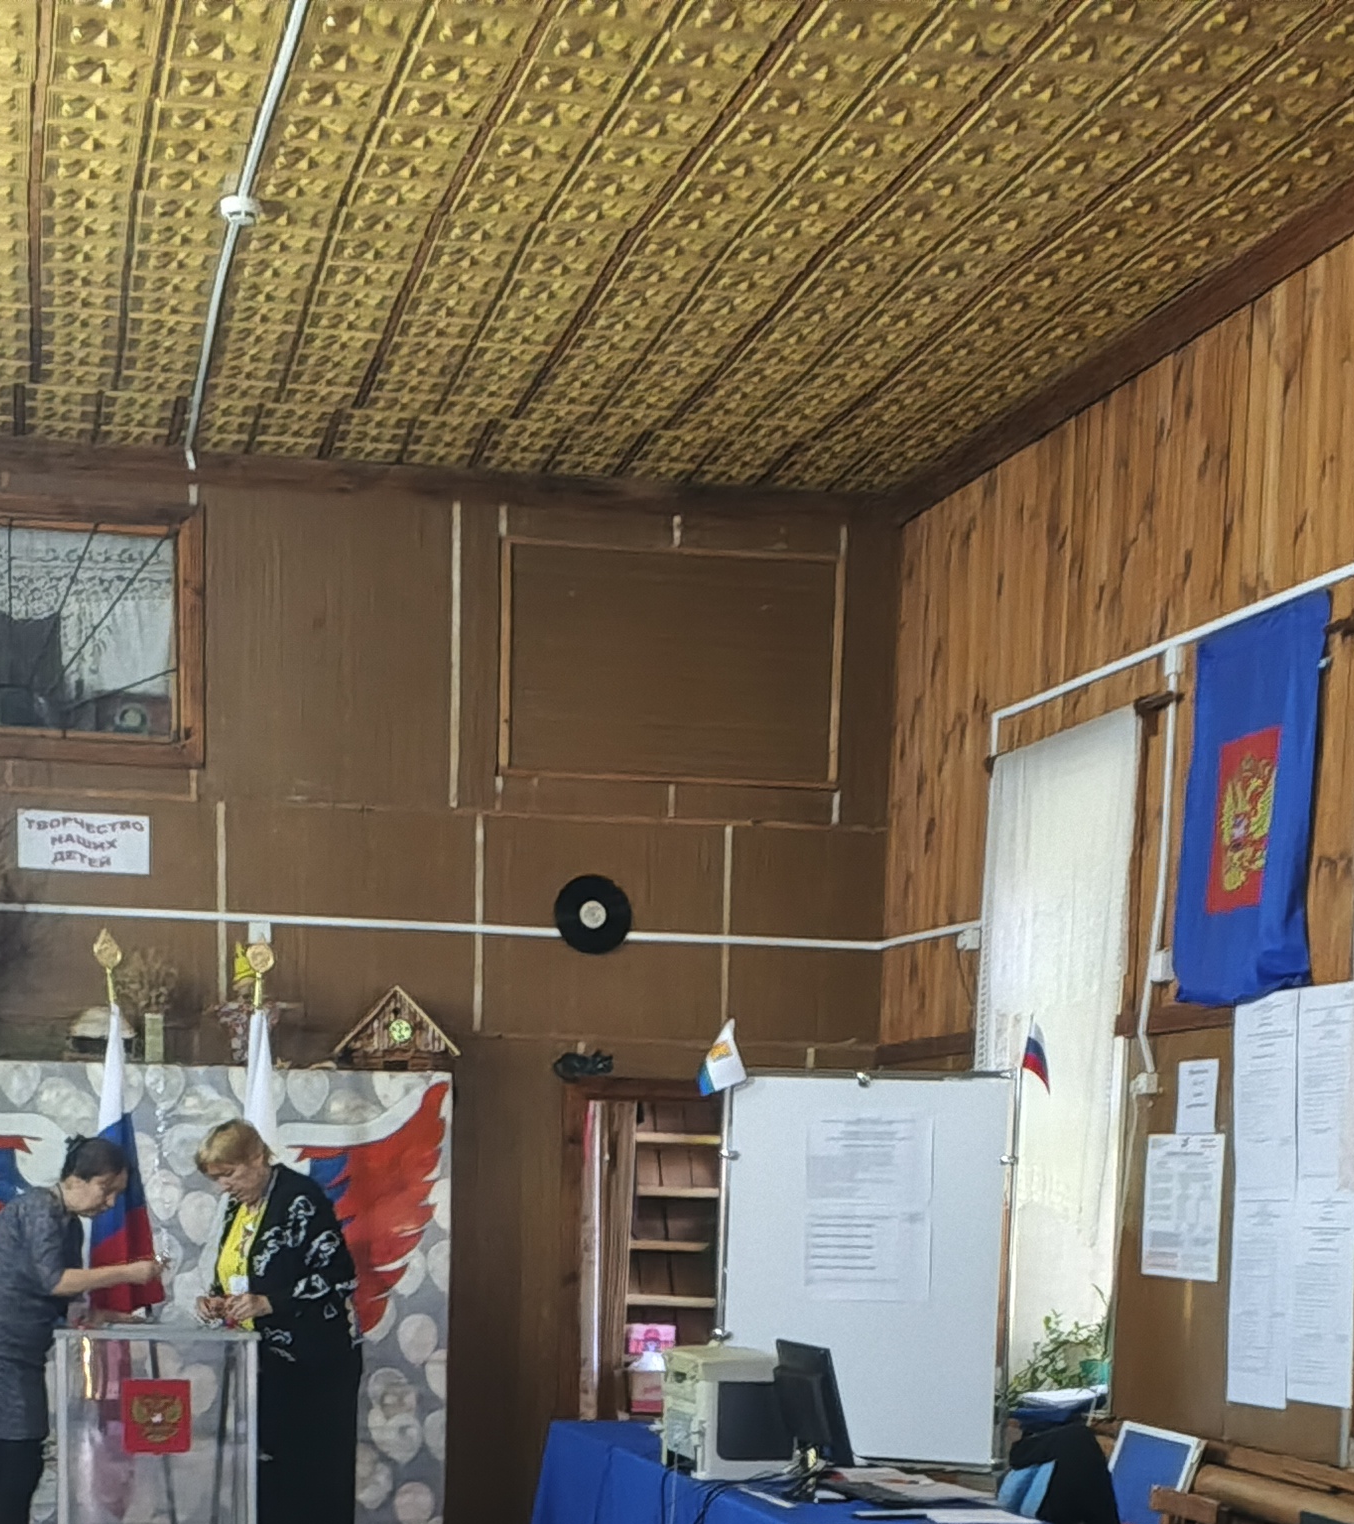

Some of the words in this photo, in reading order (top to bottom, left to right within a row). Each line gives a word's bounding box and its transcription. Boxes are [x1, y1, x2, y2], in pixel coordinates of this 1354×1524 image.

[24, 816, 145, 835] ТВОРЧЕСТВО
[49, 832, 119, 852] НАШИХ
[50, 849, 113, 869] ДЕТЕЙ
